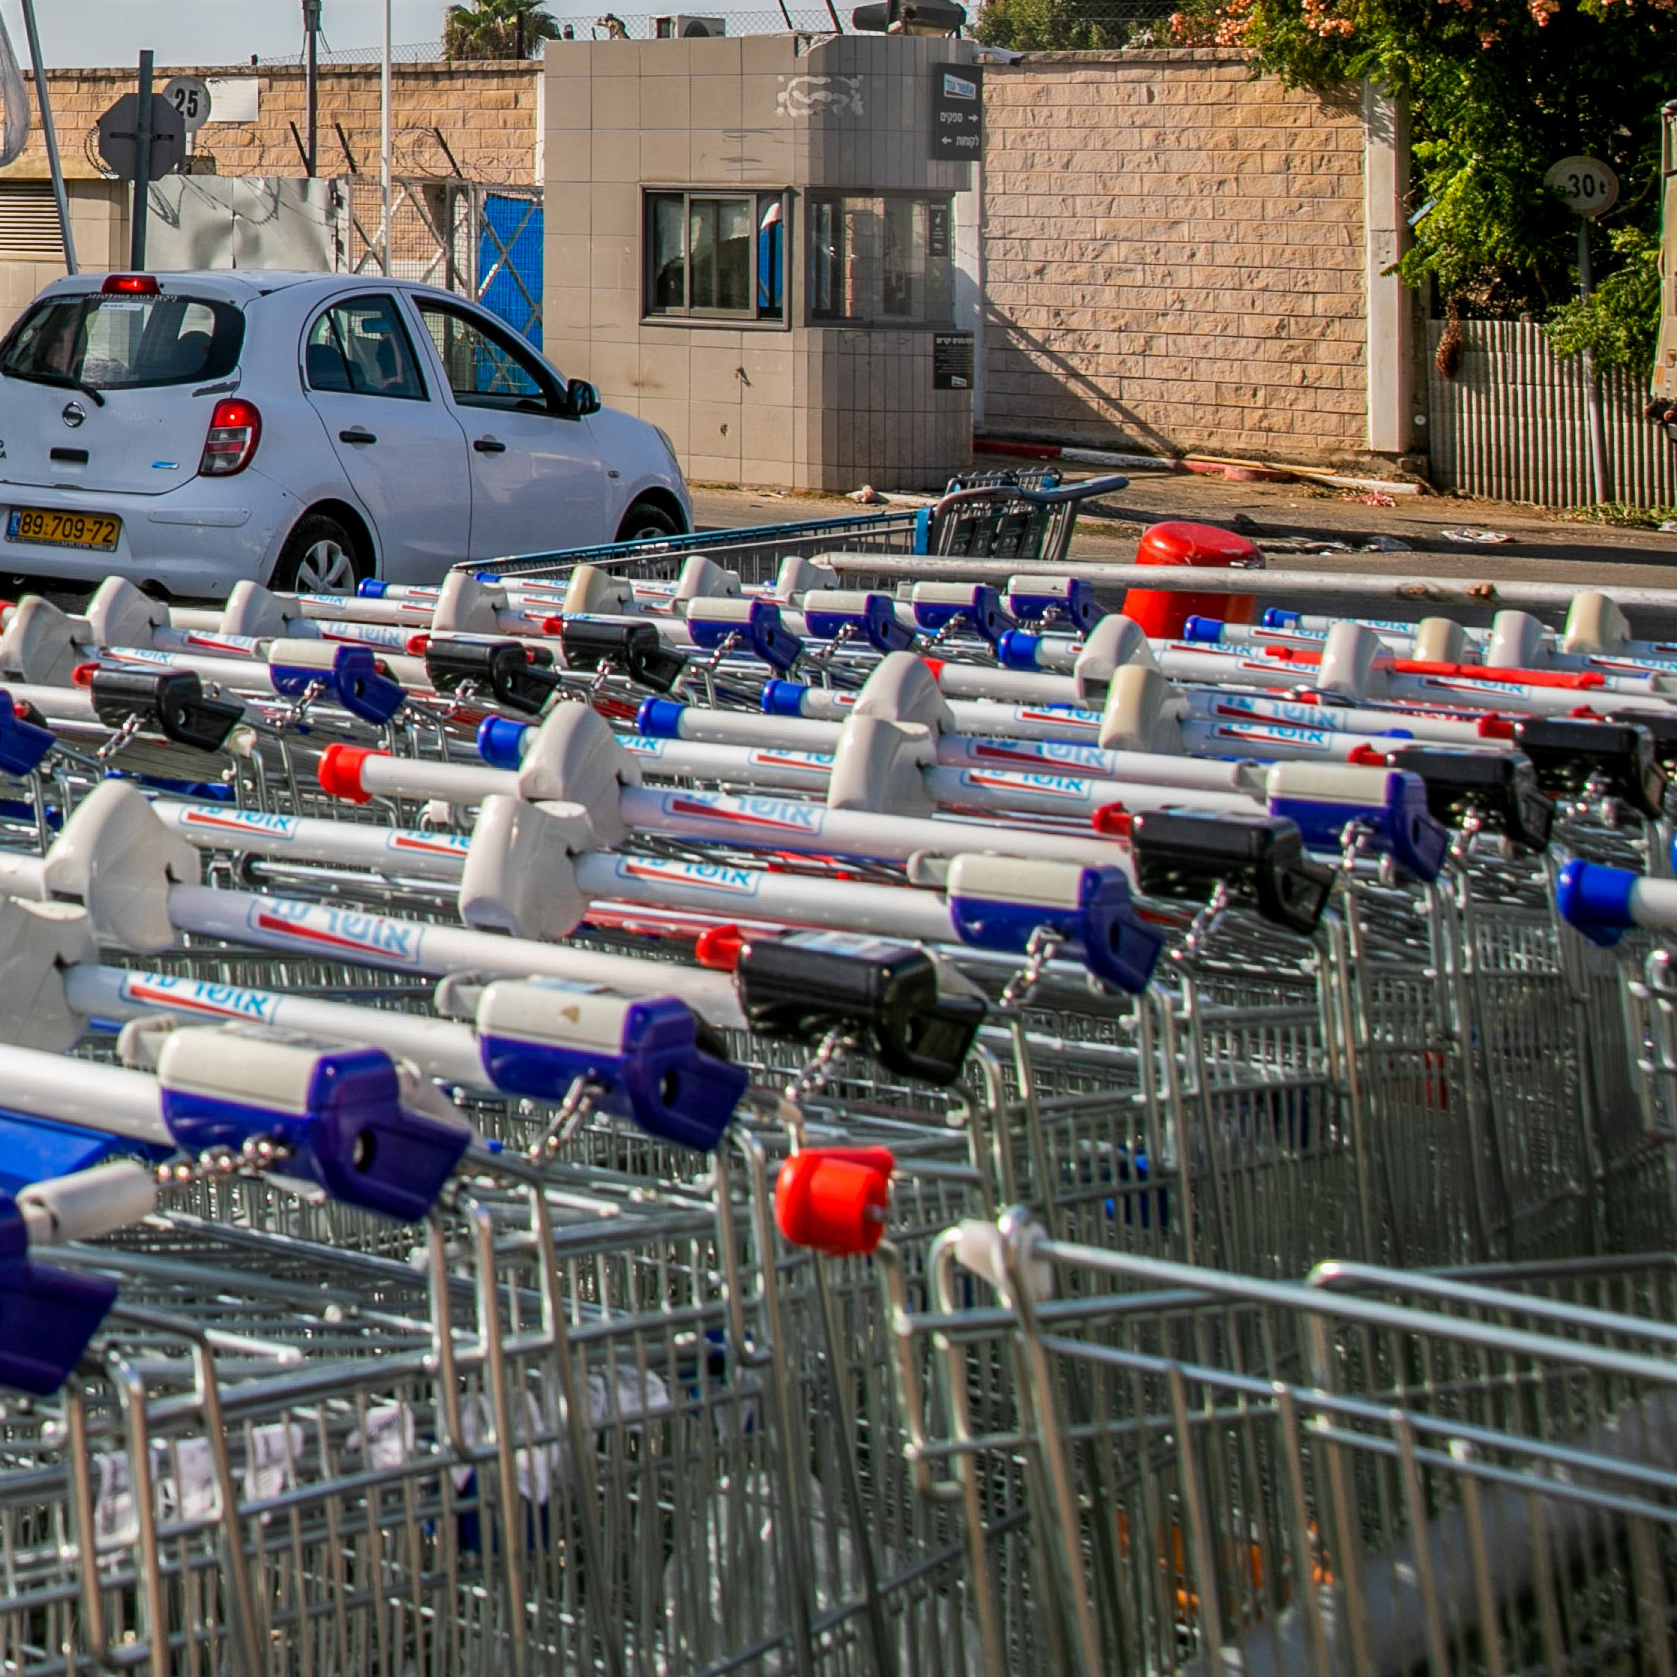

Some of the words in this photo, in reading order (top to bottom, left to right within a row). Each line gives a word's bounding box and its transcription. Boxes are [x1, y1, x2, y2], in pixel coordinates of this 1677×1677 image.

[174, 88, 199, 119] 25
[940, 111, 963, 124] ספקים
[1568, 173, 1595, 198] 30
[321, 904, 414, 956] אושר
